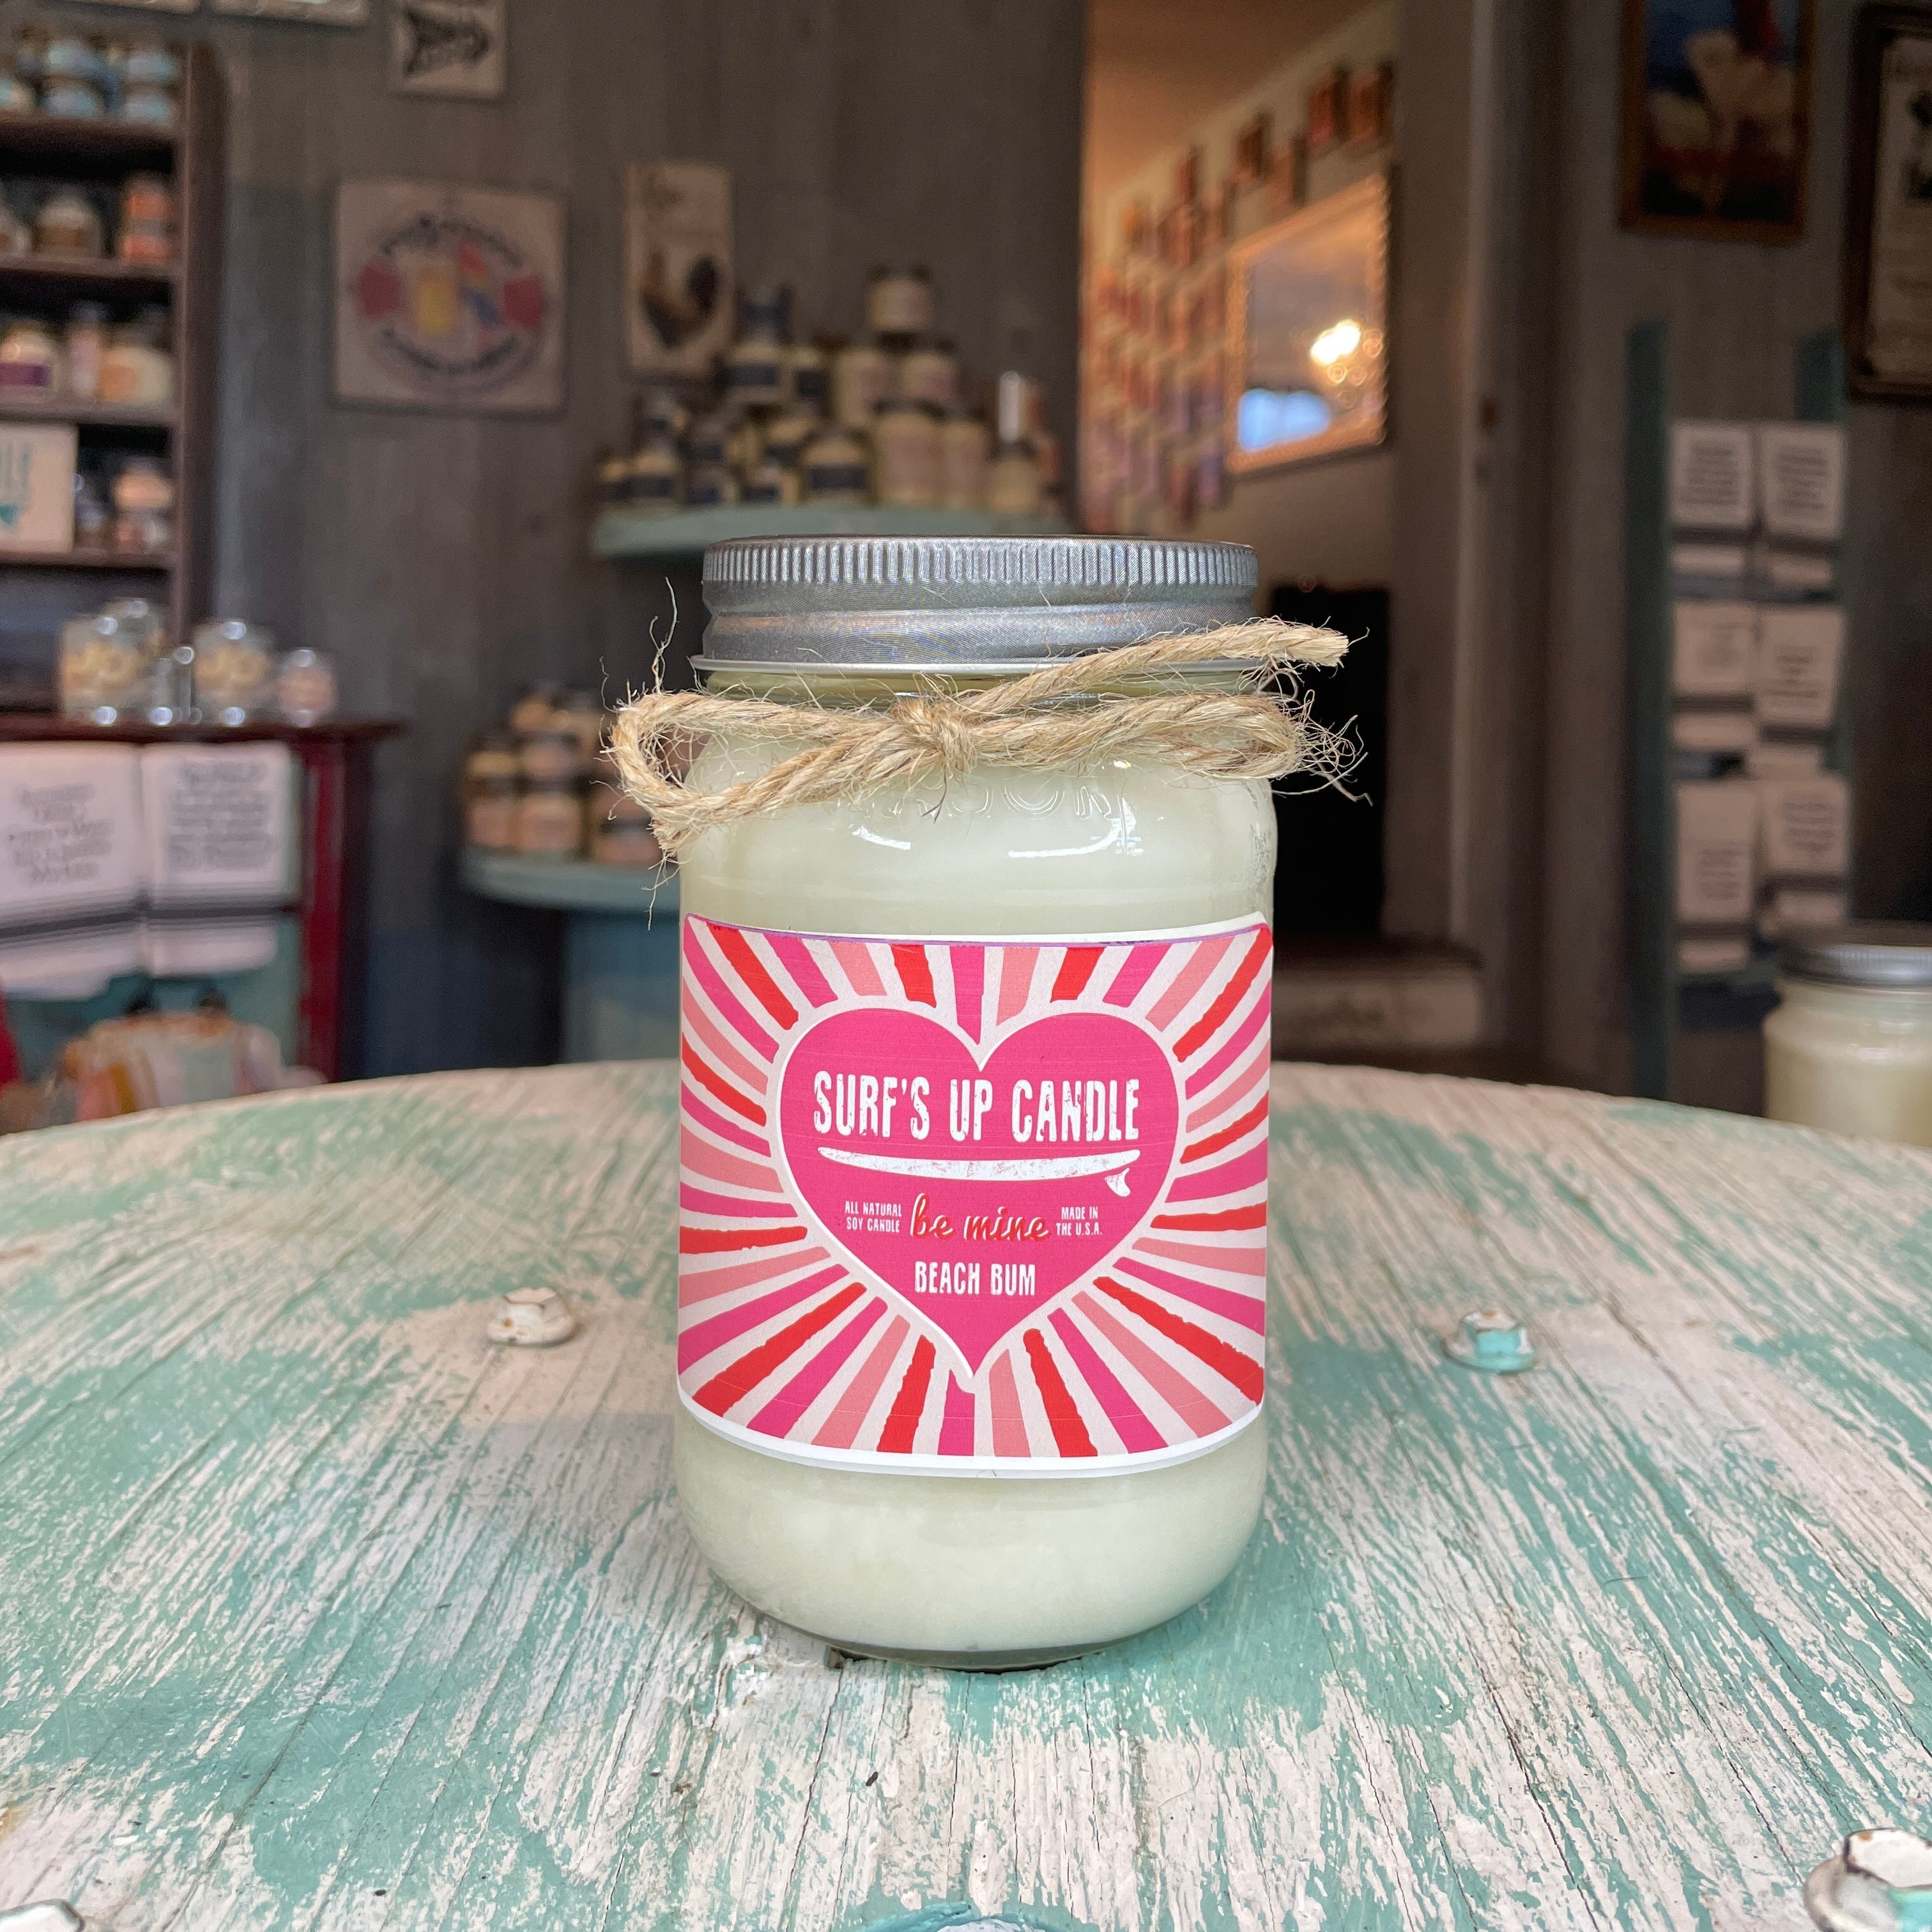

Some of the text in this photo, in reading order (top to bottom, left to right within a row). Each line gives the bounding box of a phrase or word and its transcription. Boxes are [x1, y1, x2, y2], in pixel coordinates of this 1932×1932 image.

[813, 1070, 1140, 1142] SURF'S UP CANDLE
[844, 1200, 902, 1217] ALL NATURAL
[910, 1192, 1052, 1242] be mine
[1061, 1206, 1098, 1220] MADE IN
[847, 1216, 900, 1233] SOY CANDLE
[1055, 1222, 1103, 1236] THE U.S.A.
[914, 1261, 1036, 1296] BEACH BUM
